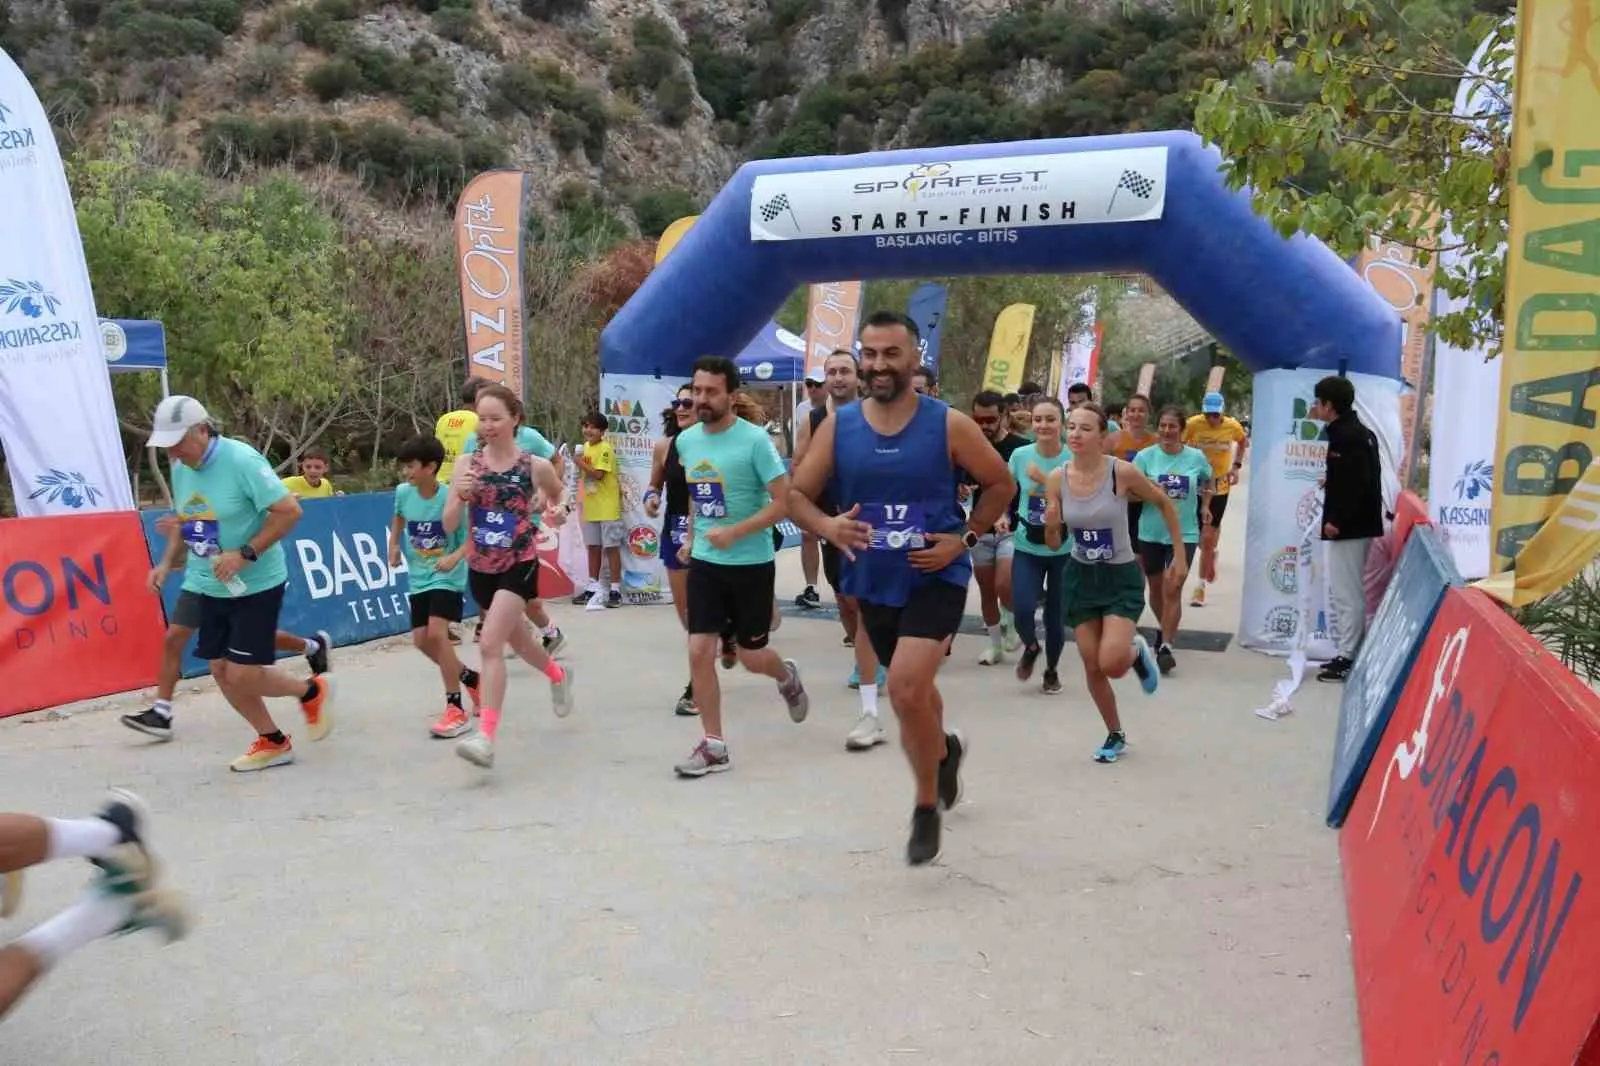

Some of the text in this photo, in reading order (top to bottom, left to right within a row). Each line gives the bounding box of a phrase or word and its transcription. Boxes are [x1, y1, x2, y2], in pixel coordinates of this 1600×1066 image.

[470, 308, 505, 388] AZ
[695, 483, 712, 496] 58
[486, 511, 504, 525] 84
[884, 504, 908, 520] 17
[1440, 505, 1491, 526] KASSAN
[1082, 530, 1099, 542] 81
